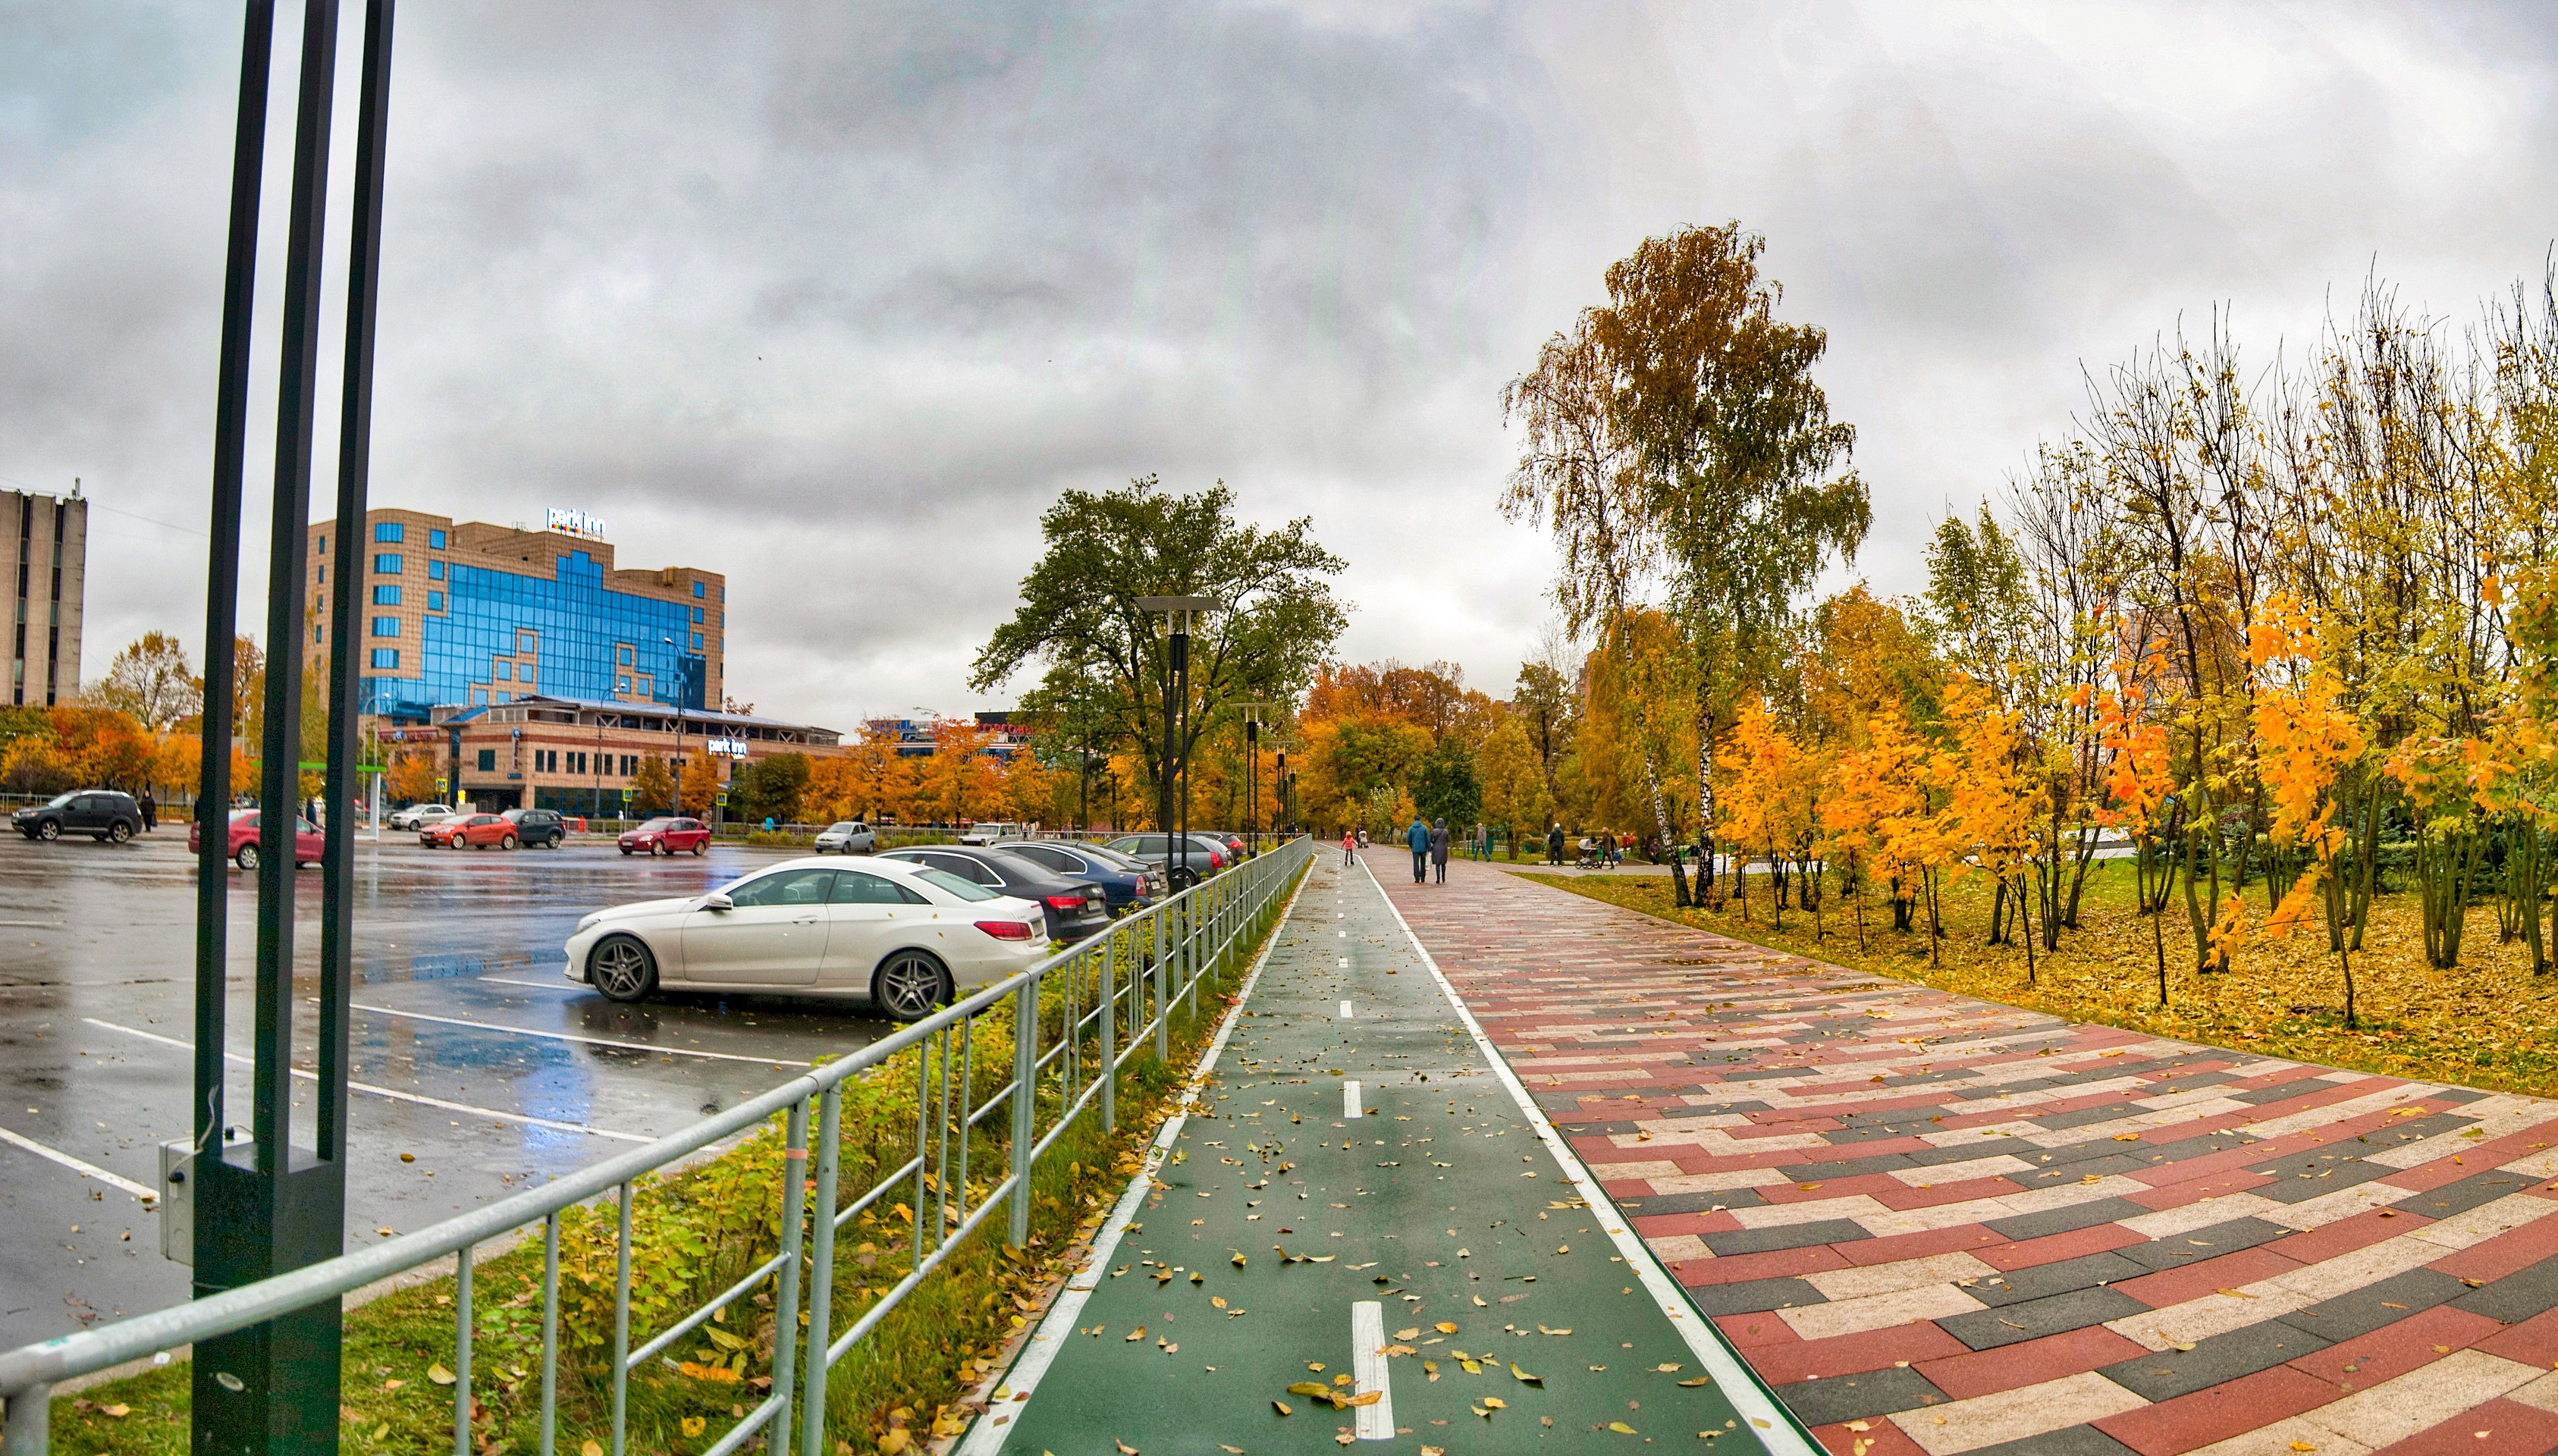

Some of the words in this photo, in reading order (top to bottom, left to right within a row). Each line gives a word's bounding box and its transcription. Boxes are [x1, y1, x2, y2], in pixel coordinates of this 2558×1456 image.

[547, 507, 582, 529] park
[582, 511, 606, 532] inn
[707, 737, 730, 756] park
